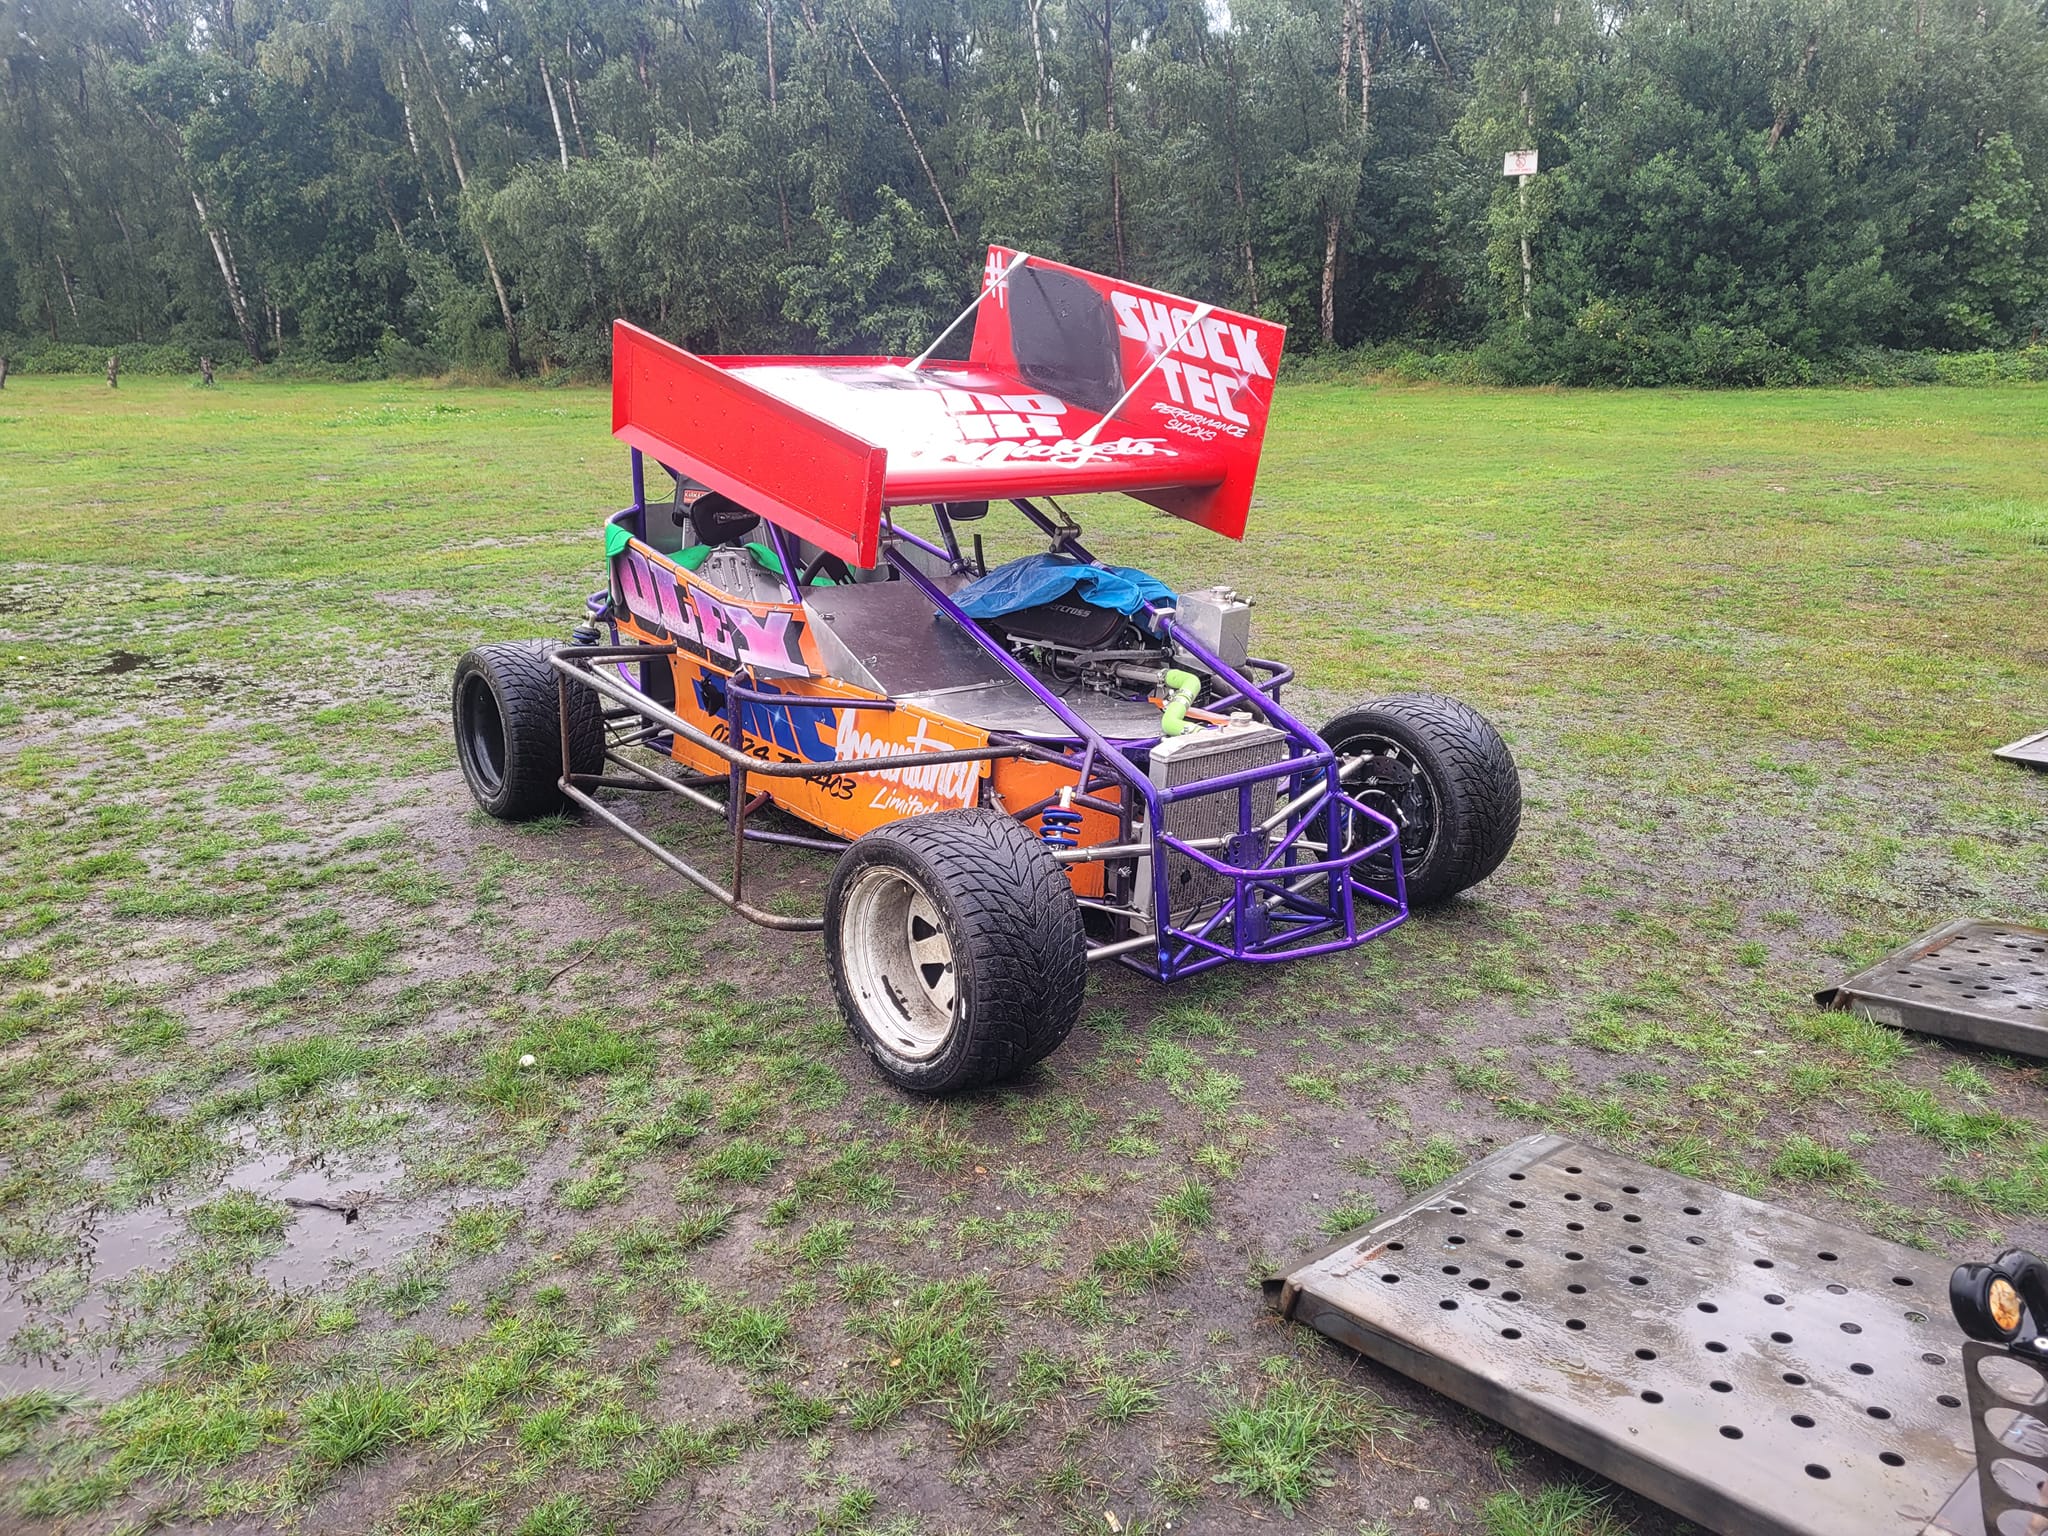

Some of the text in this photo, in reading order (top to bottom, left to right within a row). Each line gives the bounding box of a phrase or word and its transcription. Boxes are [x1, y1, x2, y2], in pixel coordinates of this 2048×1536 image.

[1110, 290, 1273, 379] SHOCK
[1150, 402, 1248, 438] PERFORMANCE
[1153, 353, 1250, 427] TEC
[1164, 418, 1217, 442] SHOCKS
[610, 545, 810, 677] OLEY
